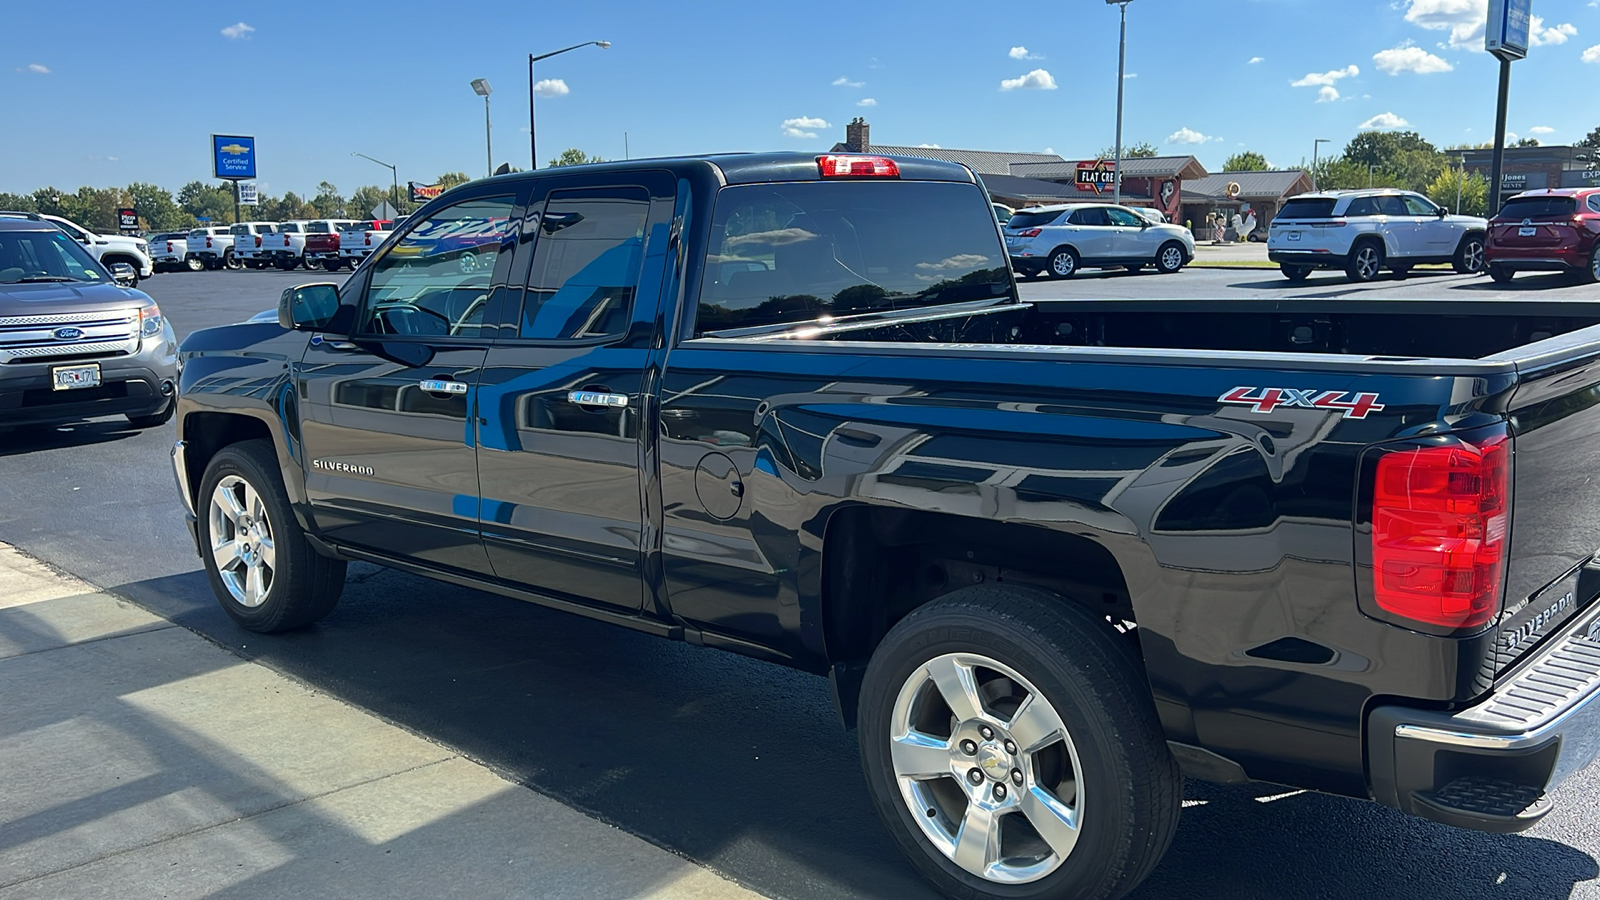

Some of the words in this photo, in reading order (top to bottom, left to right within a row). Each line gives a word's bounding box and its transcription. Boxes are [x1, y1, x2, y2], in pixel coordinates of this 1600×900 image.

[1082, 172, 1100, 182] FLAT
[1101, 172, 1122, 182] CREK
[60, 329, 79, 338] Ford
[313, 459, 375, 476] SILVERADO
[1506, 592, 1572, 652] SILVERADO
